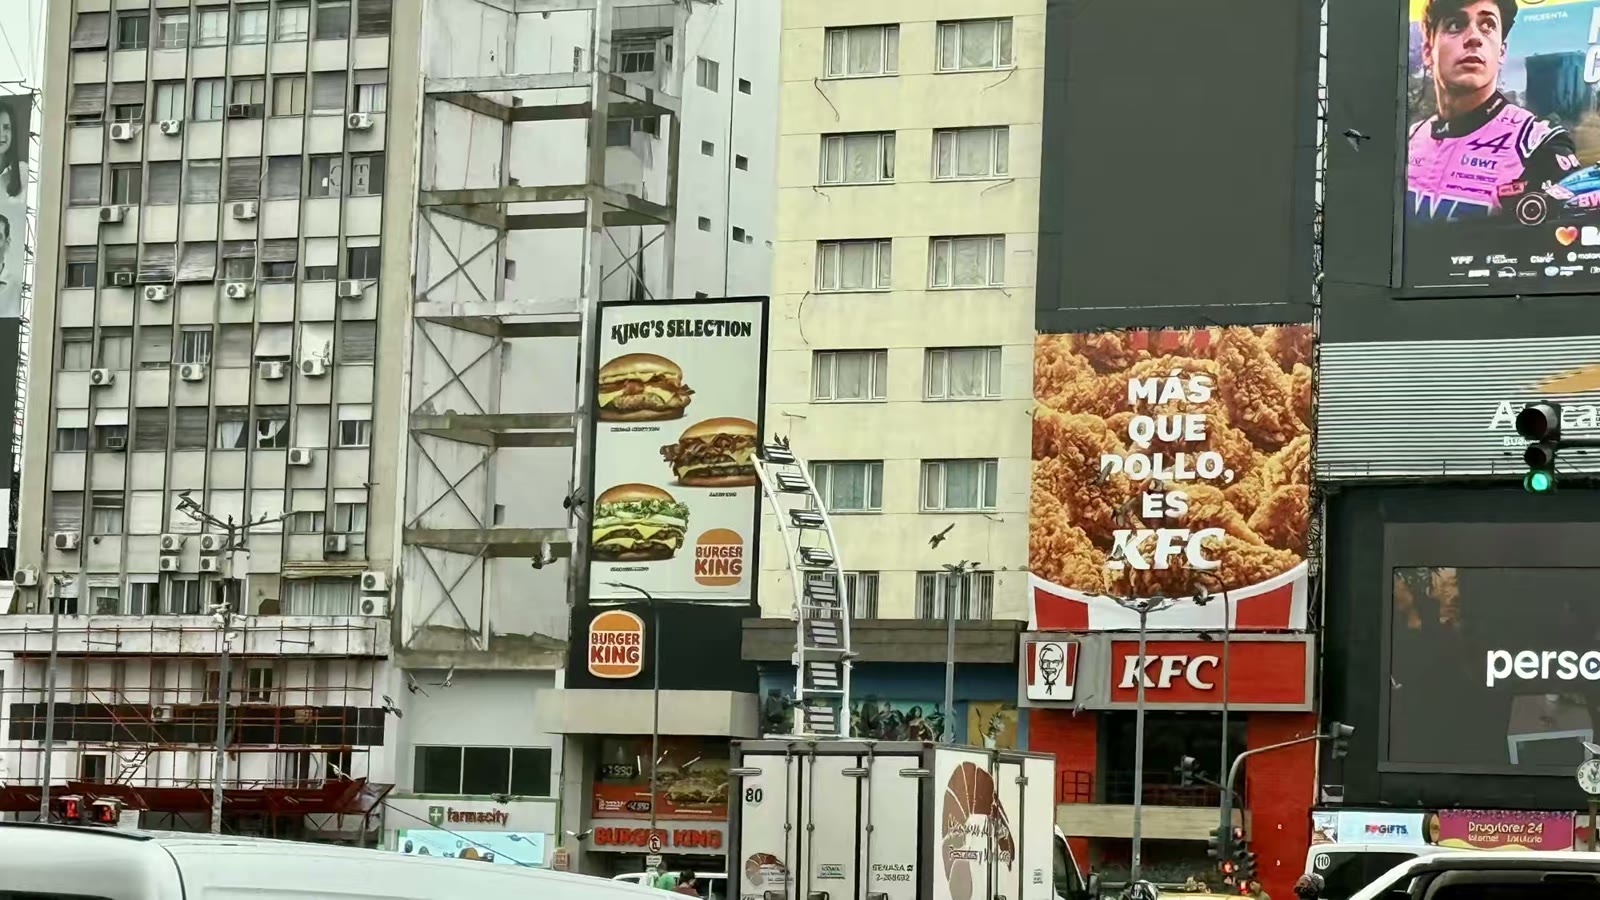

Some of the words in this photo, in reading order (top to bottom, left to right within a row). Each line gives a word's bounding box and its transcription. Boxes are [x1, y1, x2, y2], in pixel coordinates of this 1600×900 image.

[1471, 158, 1497, 169] BWT
[611, 320, 664, 345] KING'S
[667, 319, 752, 337] SELECTION
[1128, 368, 1212, 404] MÁS
[1128, 415, 1206, 448] QUE
[1100, 451, 1234, 483] POLLO,
[1142, 491, 1188, 518] ES
[695, 546, 743, 558] BURGER
[1106, 528, 1225, 569] KFC
[694, 558, 742, 576] KING
[591, 632, 640, 645] BURGER
[590, 646, 640, 663] KING
[1118, 655, 1219, 690] KFC
[745, 788, 763, 802] 80
[447, 807, 509, 827] farmacity
[1469, 821, 1525, 834] Drugstores
[1527, 822, 1543, 834] 24
[673, 829, 722, 848] KING
[1317, 856, 1329, 867] 110
